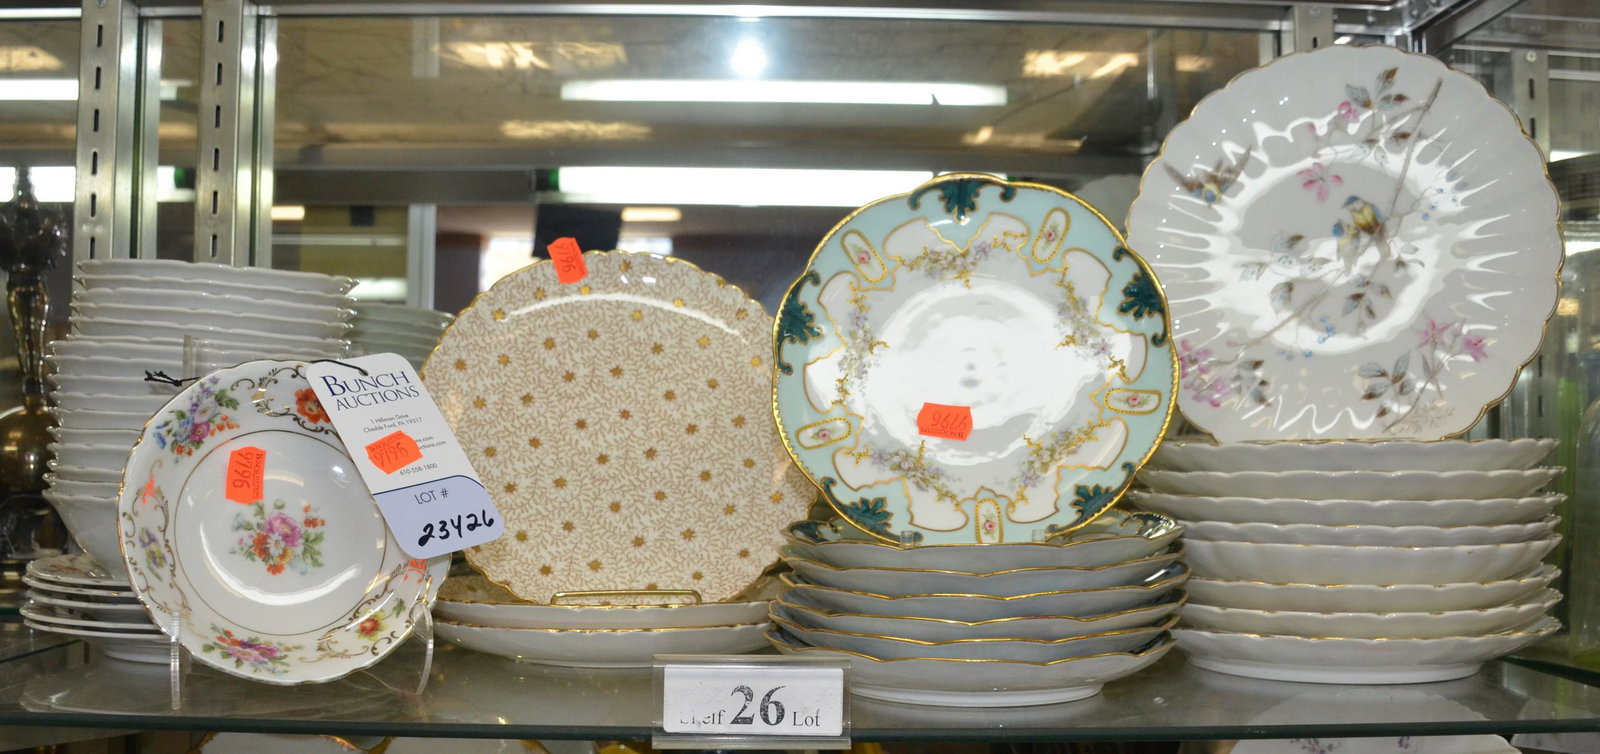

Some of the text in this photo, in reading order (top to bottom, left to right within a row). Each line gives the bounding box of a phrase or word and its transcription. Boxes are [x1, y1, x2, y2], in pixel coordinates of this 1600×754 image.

[321, 371, 410, 396] BUNCH
[337, 385, 420, 411] AUCTIONS
[414, 488, 448, 504] LOT #
[418, 509, 494, 547] 23426
[730, 685, 786, 726] 26
[793, 709, 820, 727] Lot
